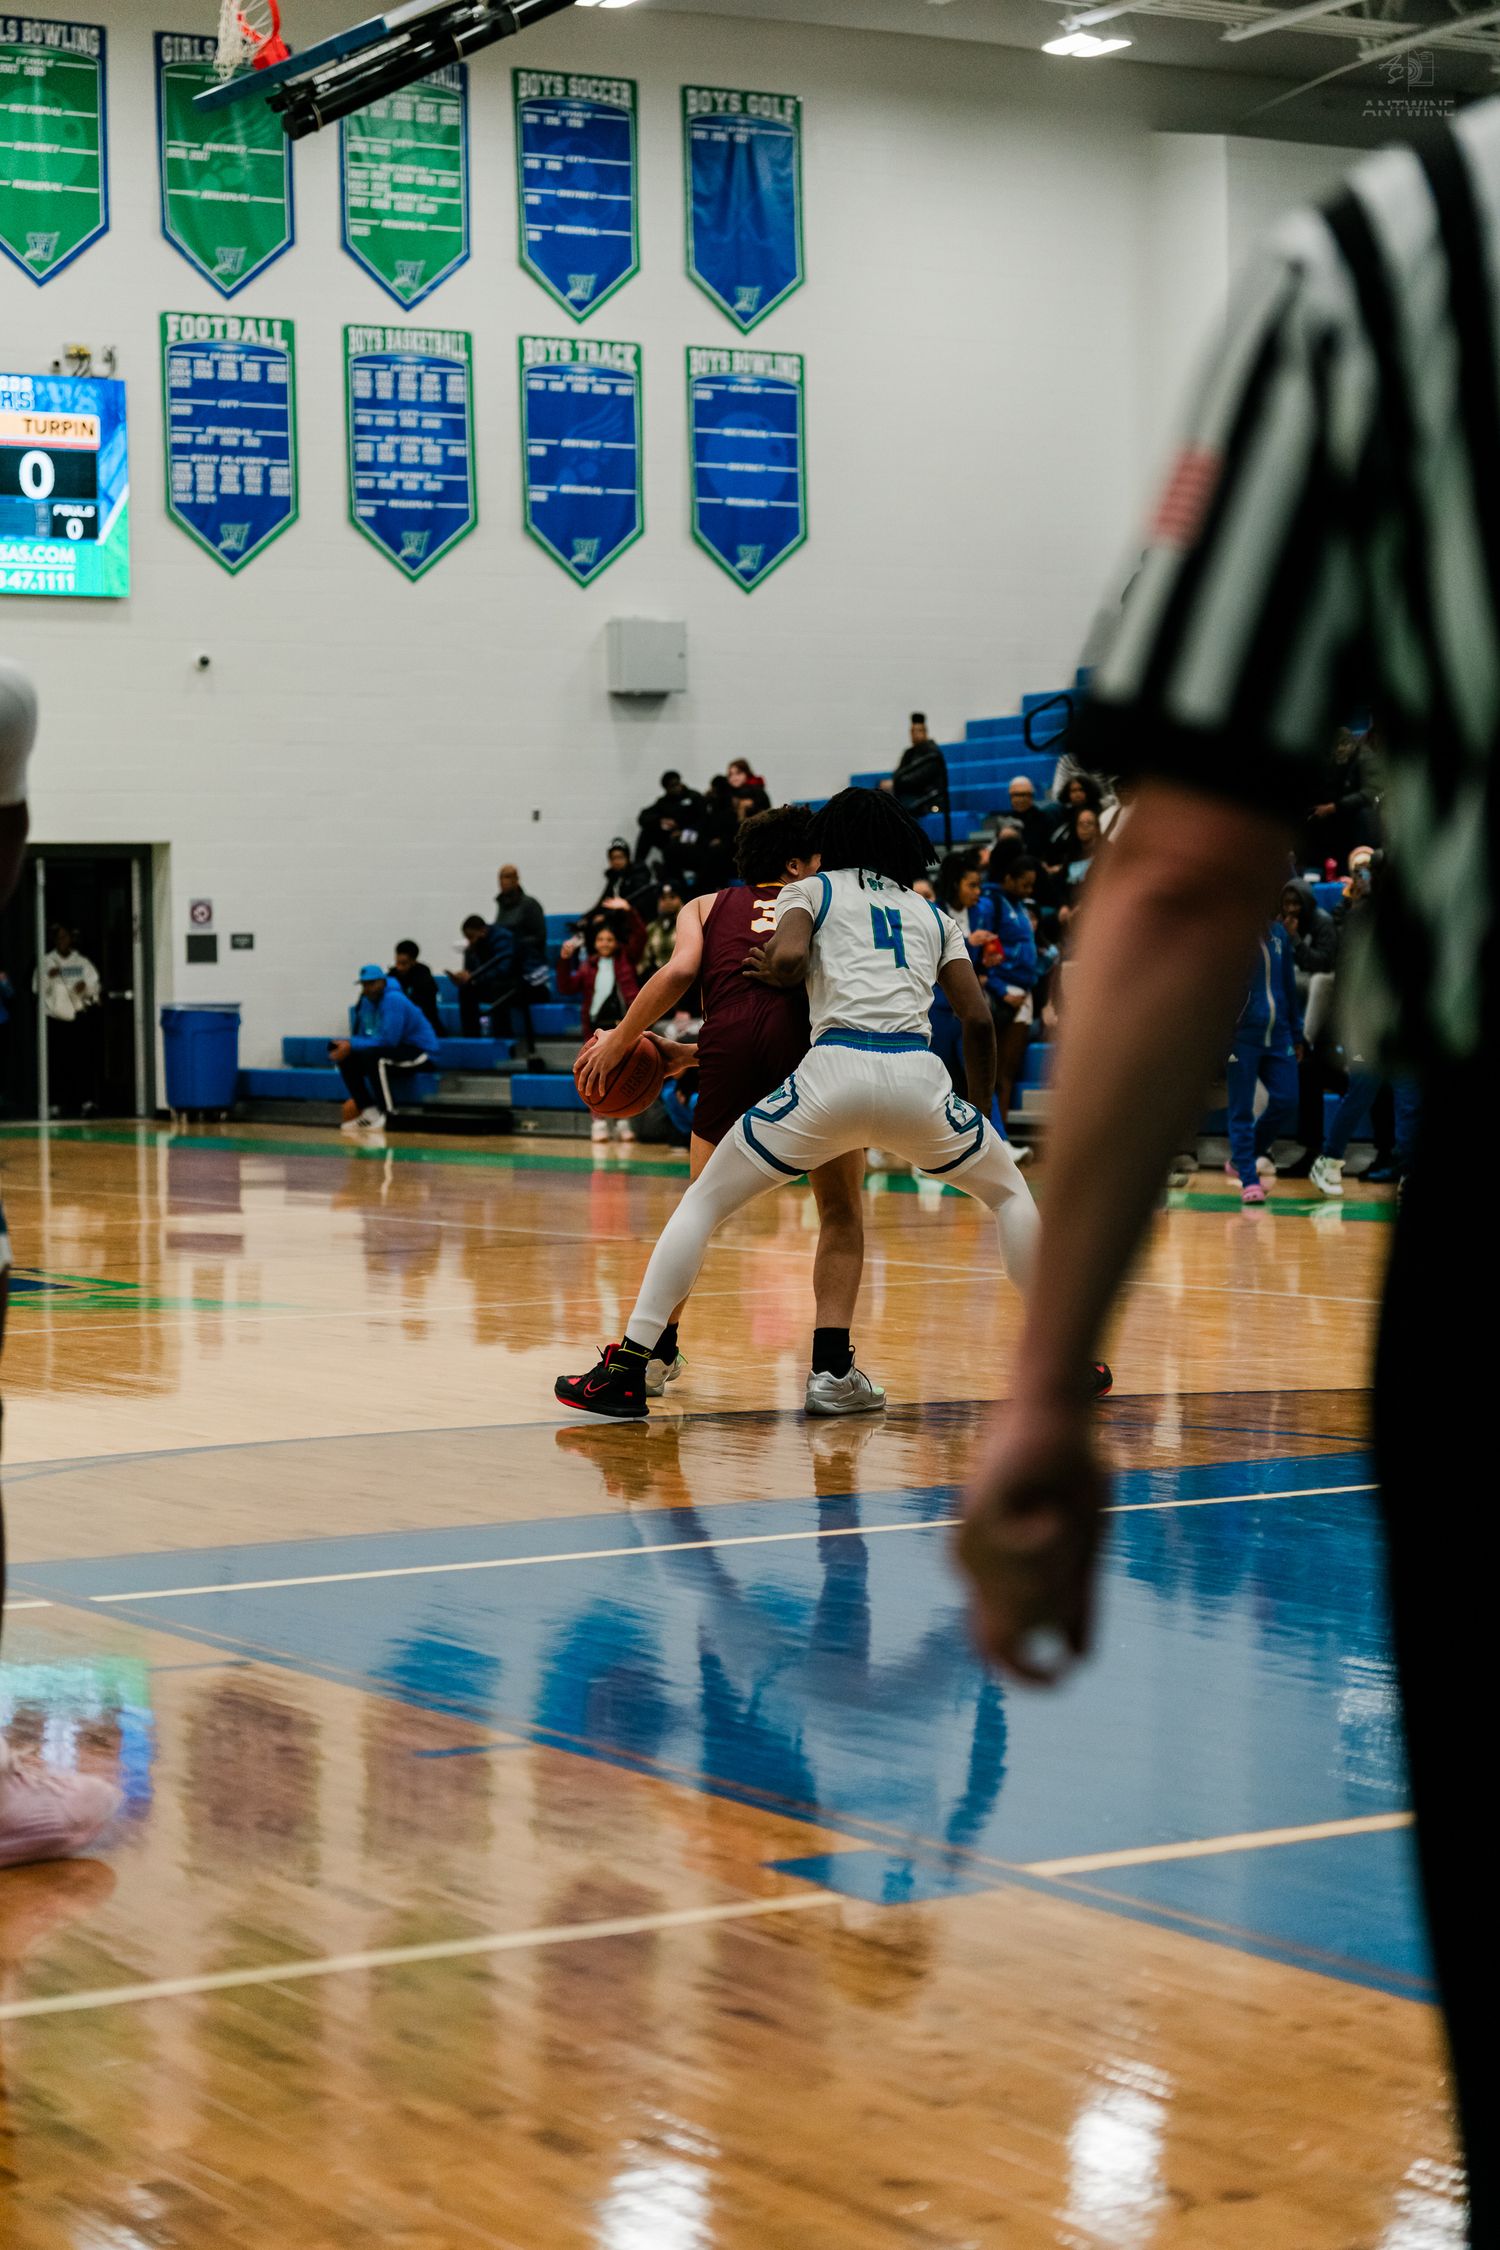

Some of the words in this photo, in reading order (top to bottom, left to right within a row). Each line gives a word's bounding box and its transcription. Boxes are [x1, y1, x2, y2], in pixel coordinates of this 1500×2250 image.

[22, 21, 99, 56] BOWLING
[162, 35, 216, 62] GIRLS
[518, 72, 564, 98] BOYS
[568, 76, 632, 107] SOCCER
[687, 88, 742, 114] BOYS
[746, 94, 796, 123] GOLF
[166, 314, 288, 349] FOOTBALL
[523, 337, 572, 365] BOYS
[575, 340, 638, 371] TRACK
[23, 418, 94, 437] TURPIN
[19, 450, 55, 500] 0
[66, 518, 84, 540] 0
[870, 902, 909, 969] 4
